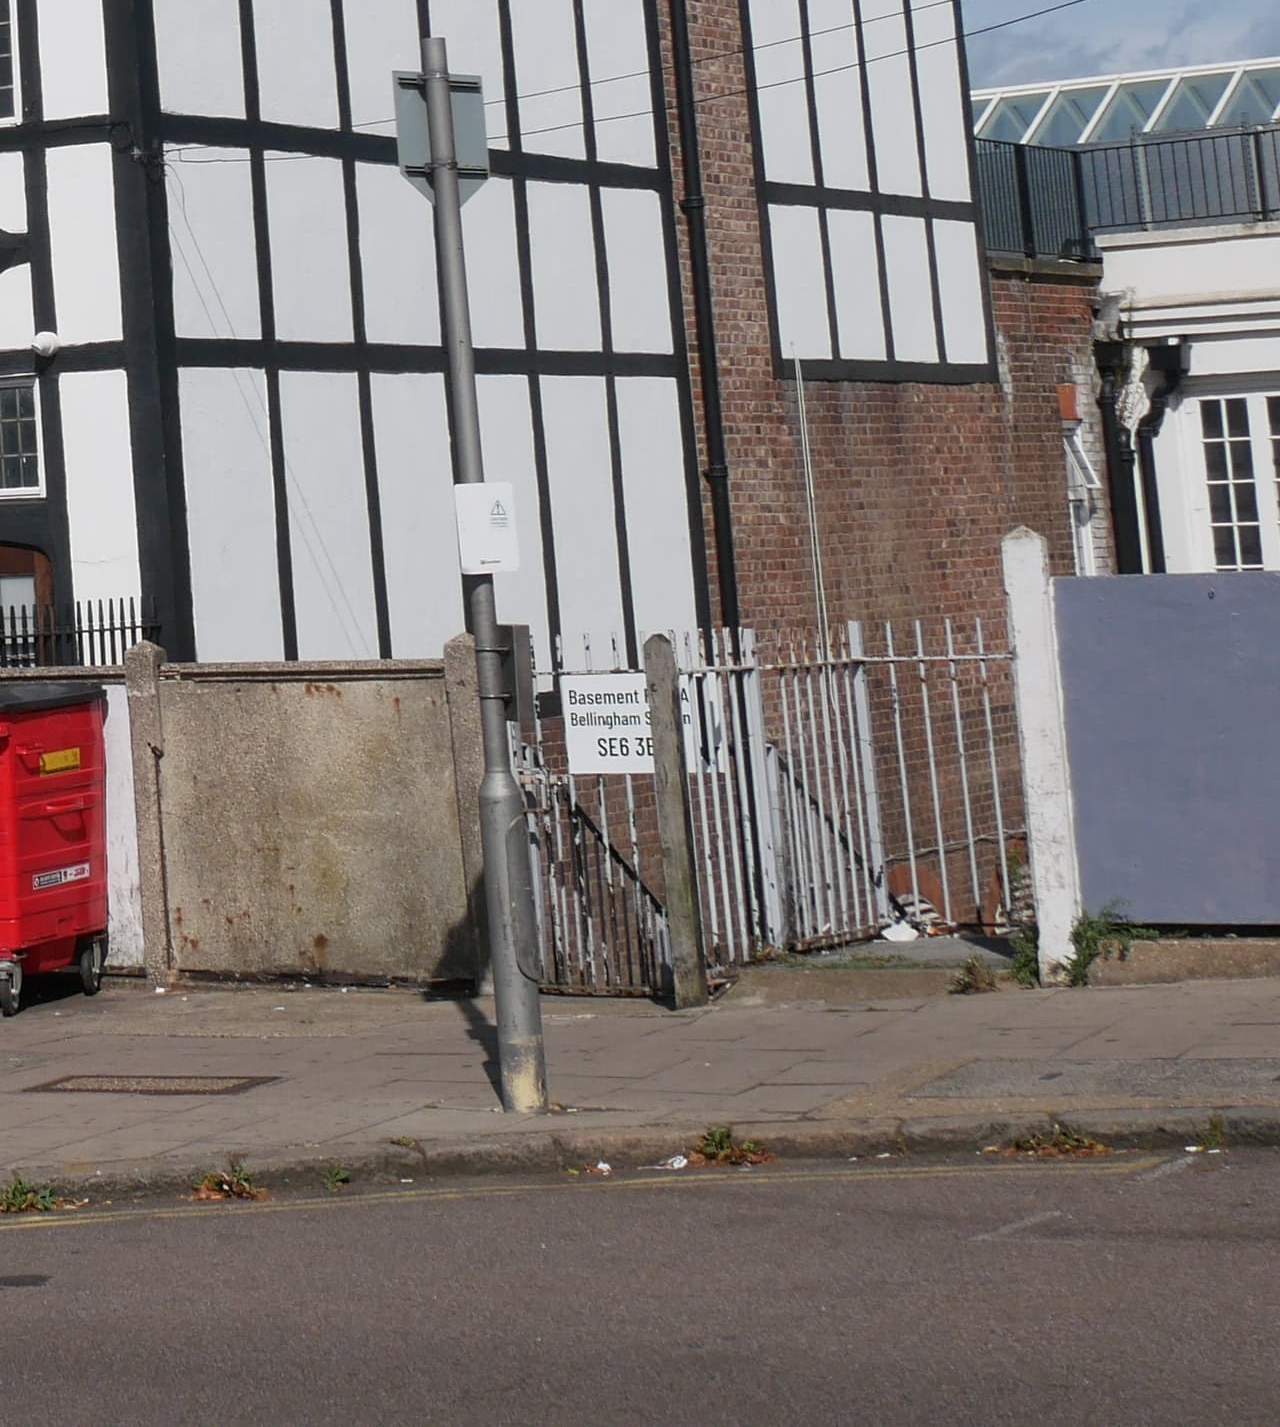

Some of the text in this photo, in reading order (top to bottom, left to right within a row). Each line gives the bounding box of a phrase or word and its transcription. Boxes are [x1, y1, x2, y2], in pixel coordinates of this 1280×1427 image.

[568, 689, 640, 705] Basement
[680, 688, 689, 703] A
[570, 711, 641, 730] Bellingham
[597, 737, 630, 757] SE6
